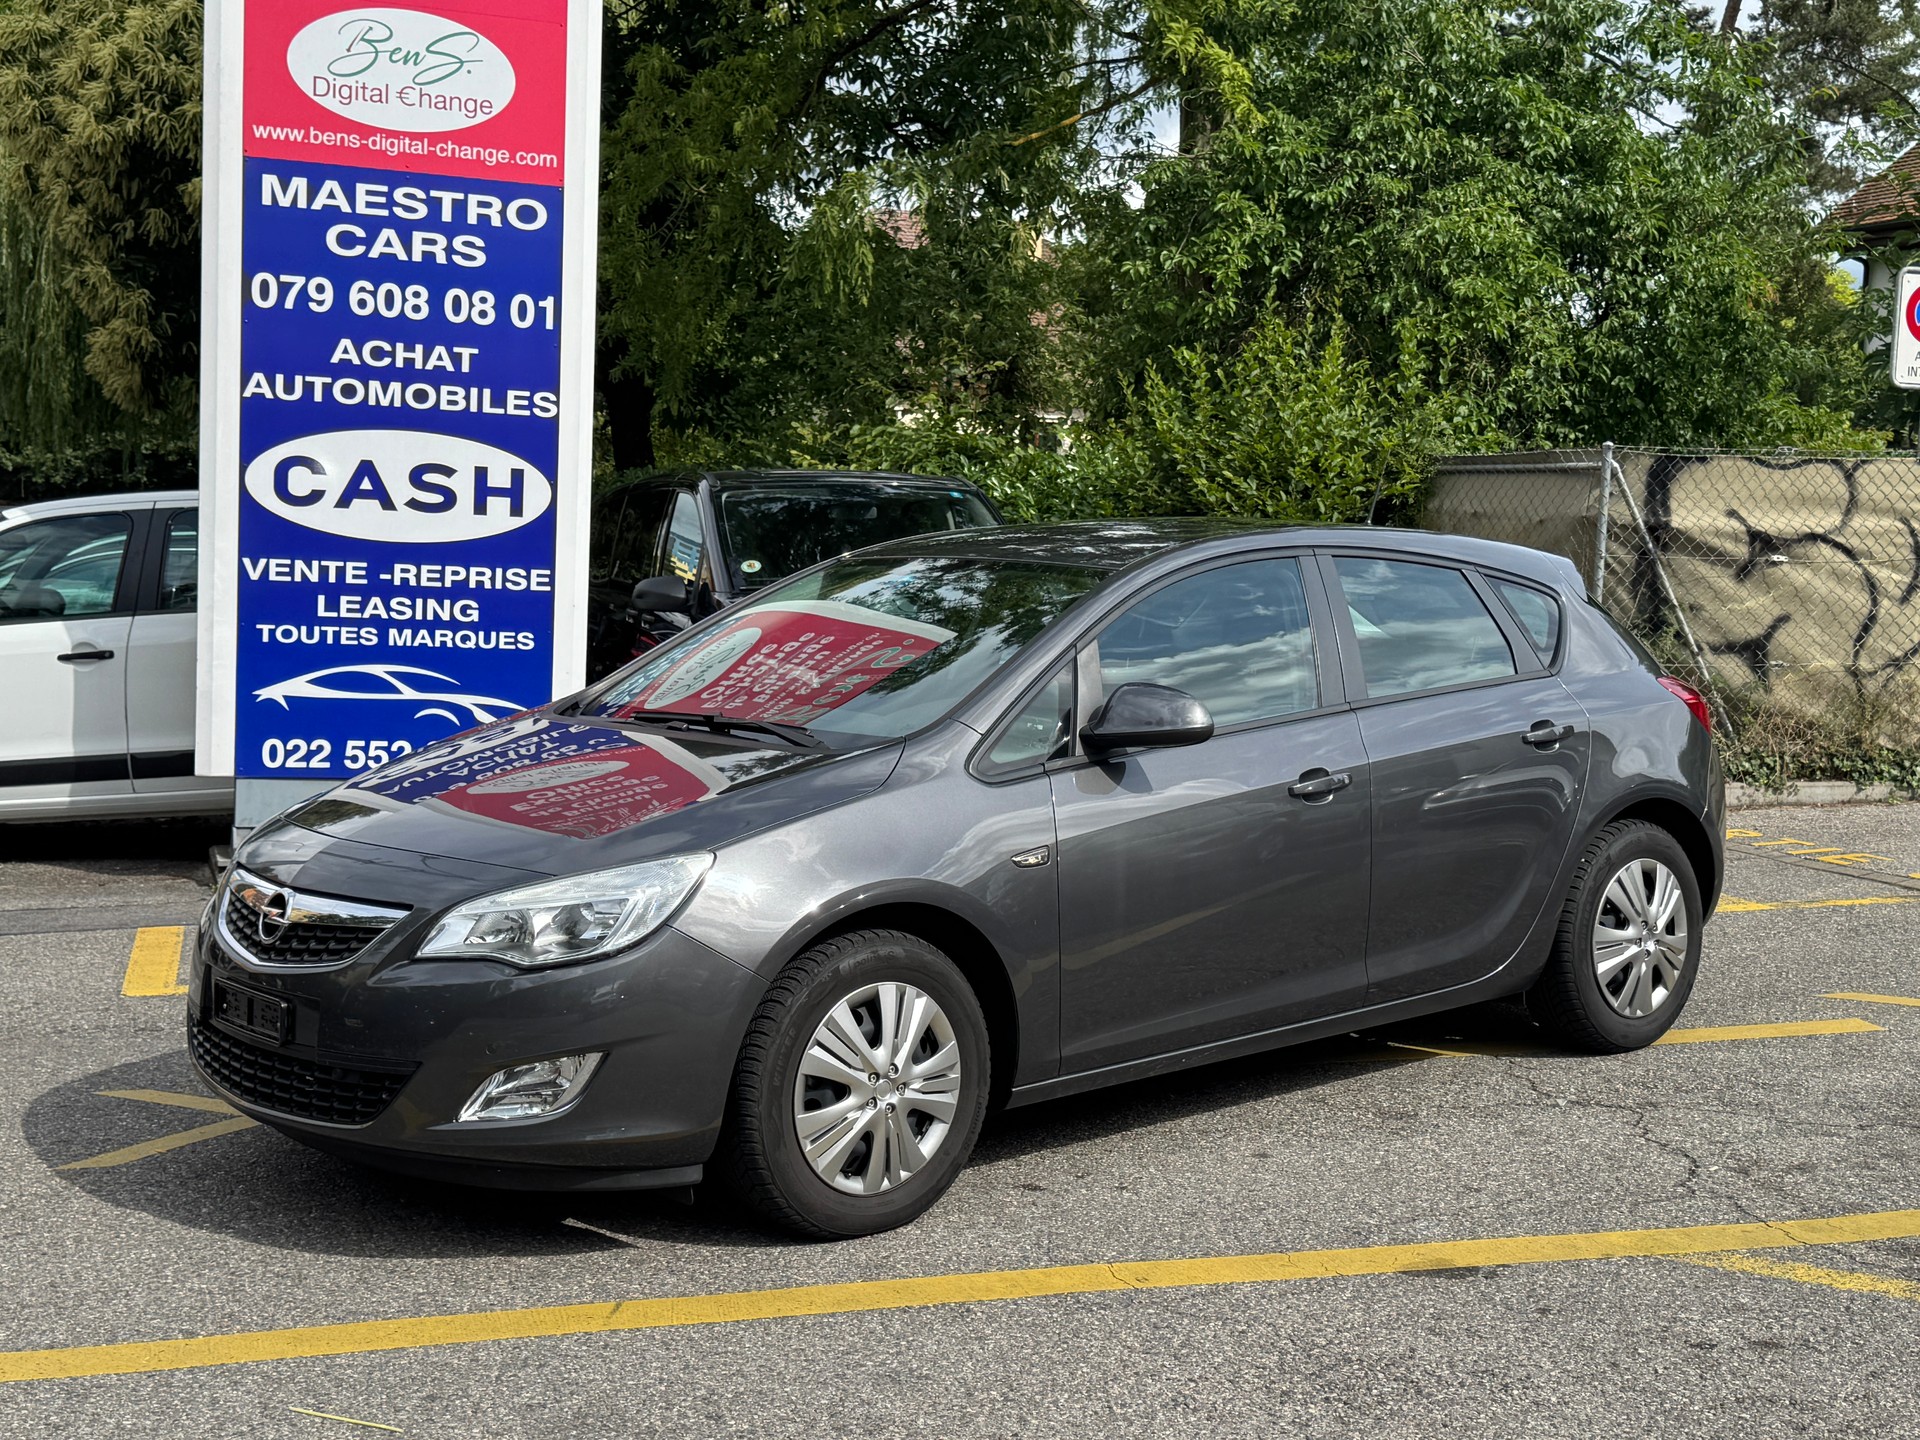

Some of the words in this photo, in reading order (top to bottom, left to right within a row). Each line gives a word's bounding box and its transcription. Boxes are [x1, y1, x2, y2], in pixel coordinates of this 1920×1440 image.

[312, 76, 389, 105] Digital
[252, 124, 558, 168] www.bens-digital-change.com
[261, 173, 548, 231] MAESTRO
[325, 224, 487, 268] CARS
[251, 272, 334, 312] 079
[349, 280, 430, 320] 608
[444, 288, 496, 326] 08
[510, 294, 555, 330] 01
[330, 338, 479, 373] ACHAT
[242, 371, 558, 419] AUTOMOBILES
[273, 455, 525, 518] CASH
[242, 557, 368, 585] VENTE
[379, 563, 552, 592] -REPRISE
[317, 594, 480, 622] LEASING
[256, 624, 379, 646] TOUTES
[388, 628, 536, 651] MARQUES
[261, 738, 331, 768] 022
